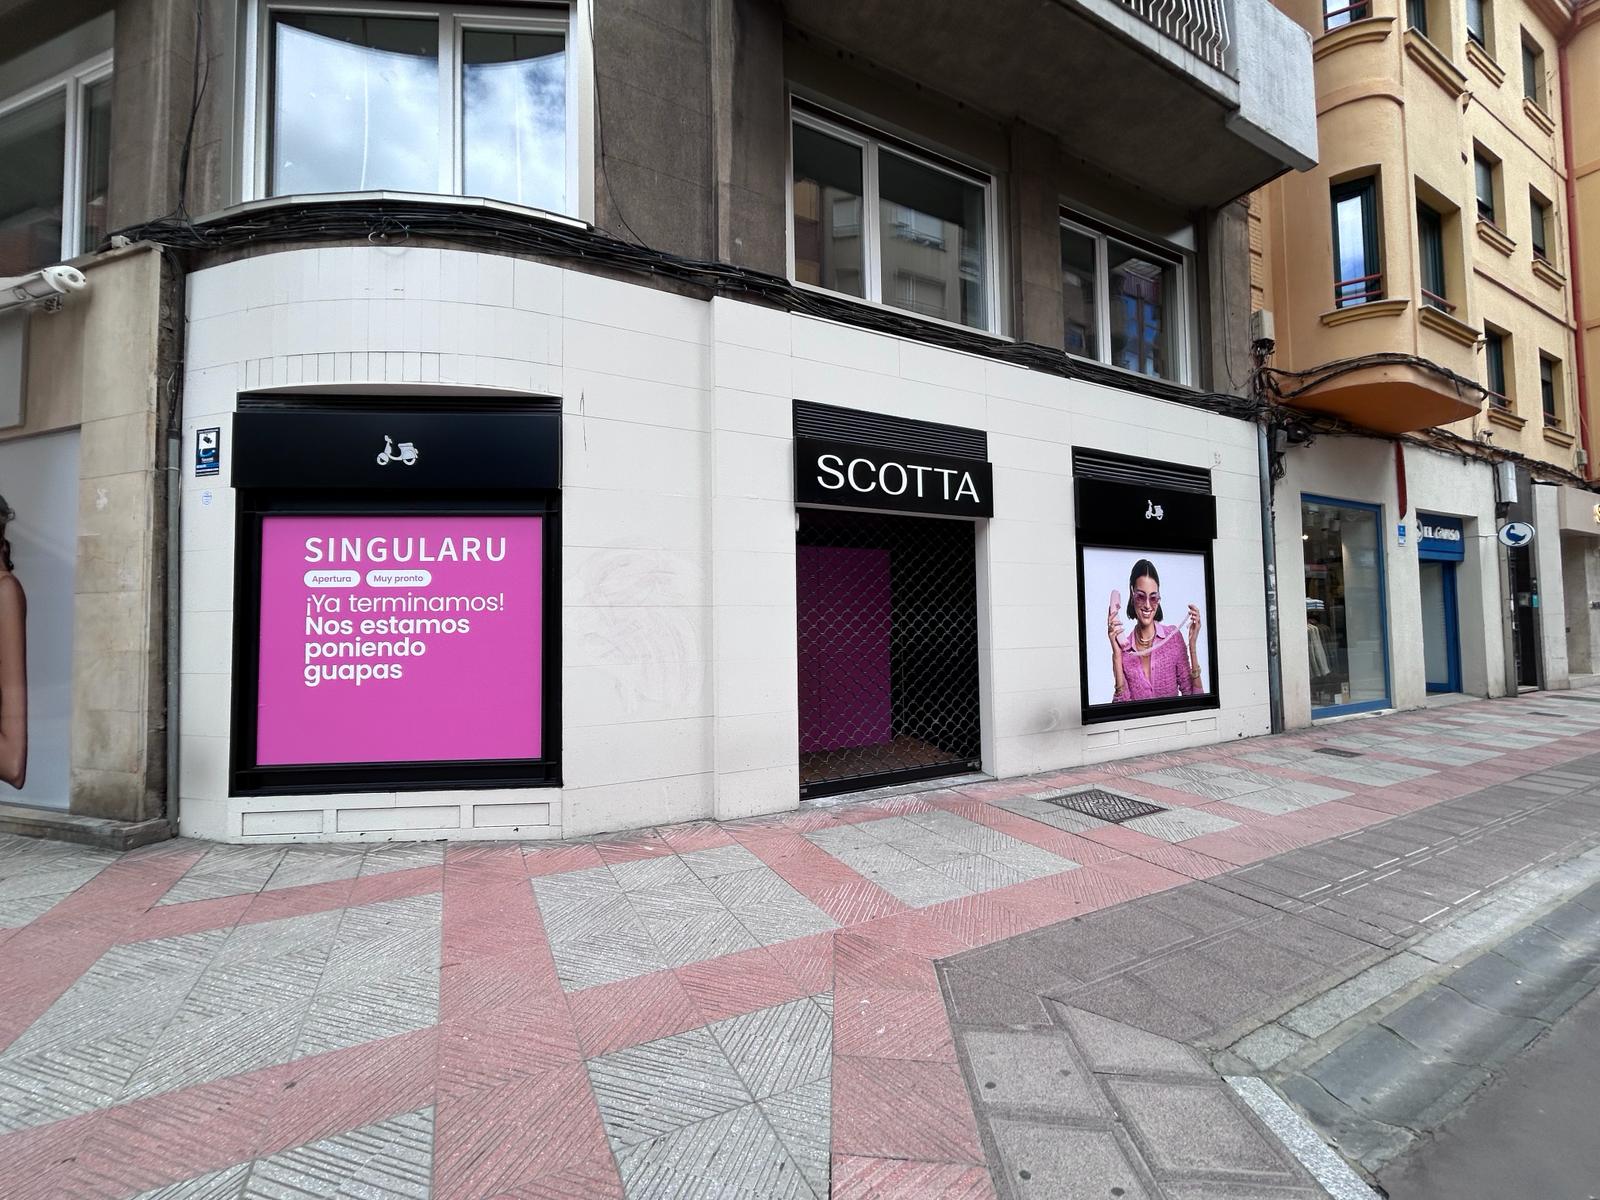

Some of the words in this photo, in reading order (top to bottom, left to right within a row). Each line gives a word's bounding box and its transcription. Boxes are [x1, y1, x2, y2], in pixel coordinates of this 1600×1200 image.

[817, 454, 980, 503] SCOTTA
[304, 537, 506, 562] SINGULARU
[311, 575, 352, 583] Apertura
[373, 575, 392, 583] Muy
[394, 574, 424, 583] pronto
[306, 594, 340, 616] ¡Ya
[349, 592, 504, 612] terminamos!
[305, 616, 353, 635] Nos
[360, 616, 470, 634] estamos
[305, 637, 426, 664] poniendo
[304, 663, 403, 687] guapas
